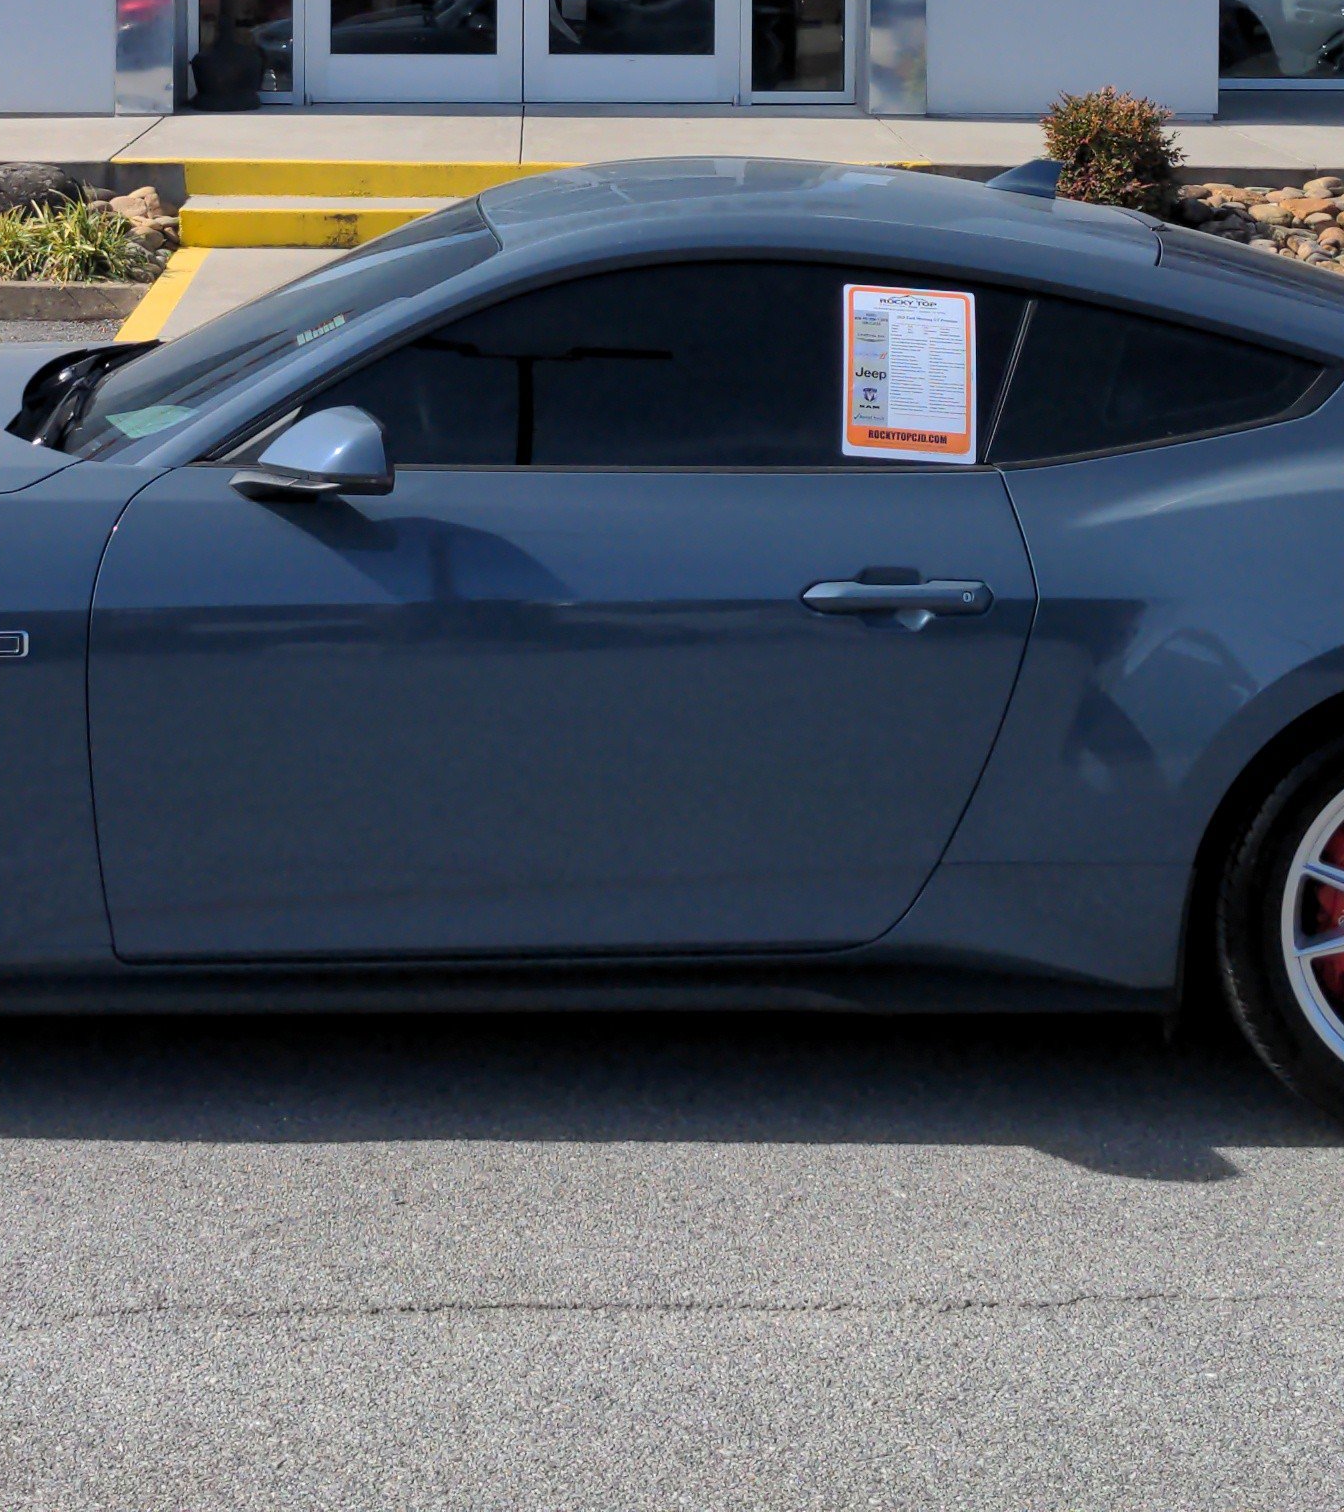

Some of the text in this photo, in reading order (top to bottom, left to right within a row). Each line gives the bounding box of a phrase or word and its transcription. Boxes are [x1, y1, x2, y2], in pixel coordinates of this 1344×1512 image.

[879, 297, 937, 308] ROCKY TOP
[855, 367, 887, 381] Jeep
[868, 429, 948, 445] ROCKYTOPCJD.COM
